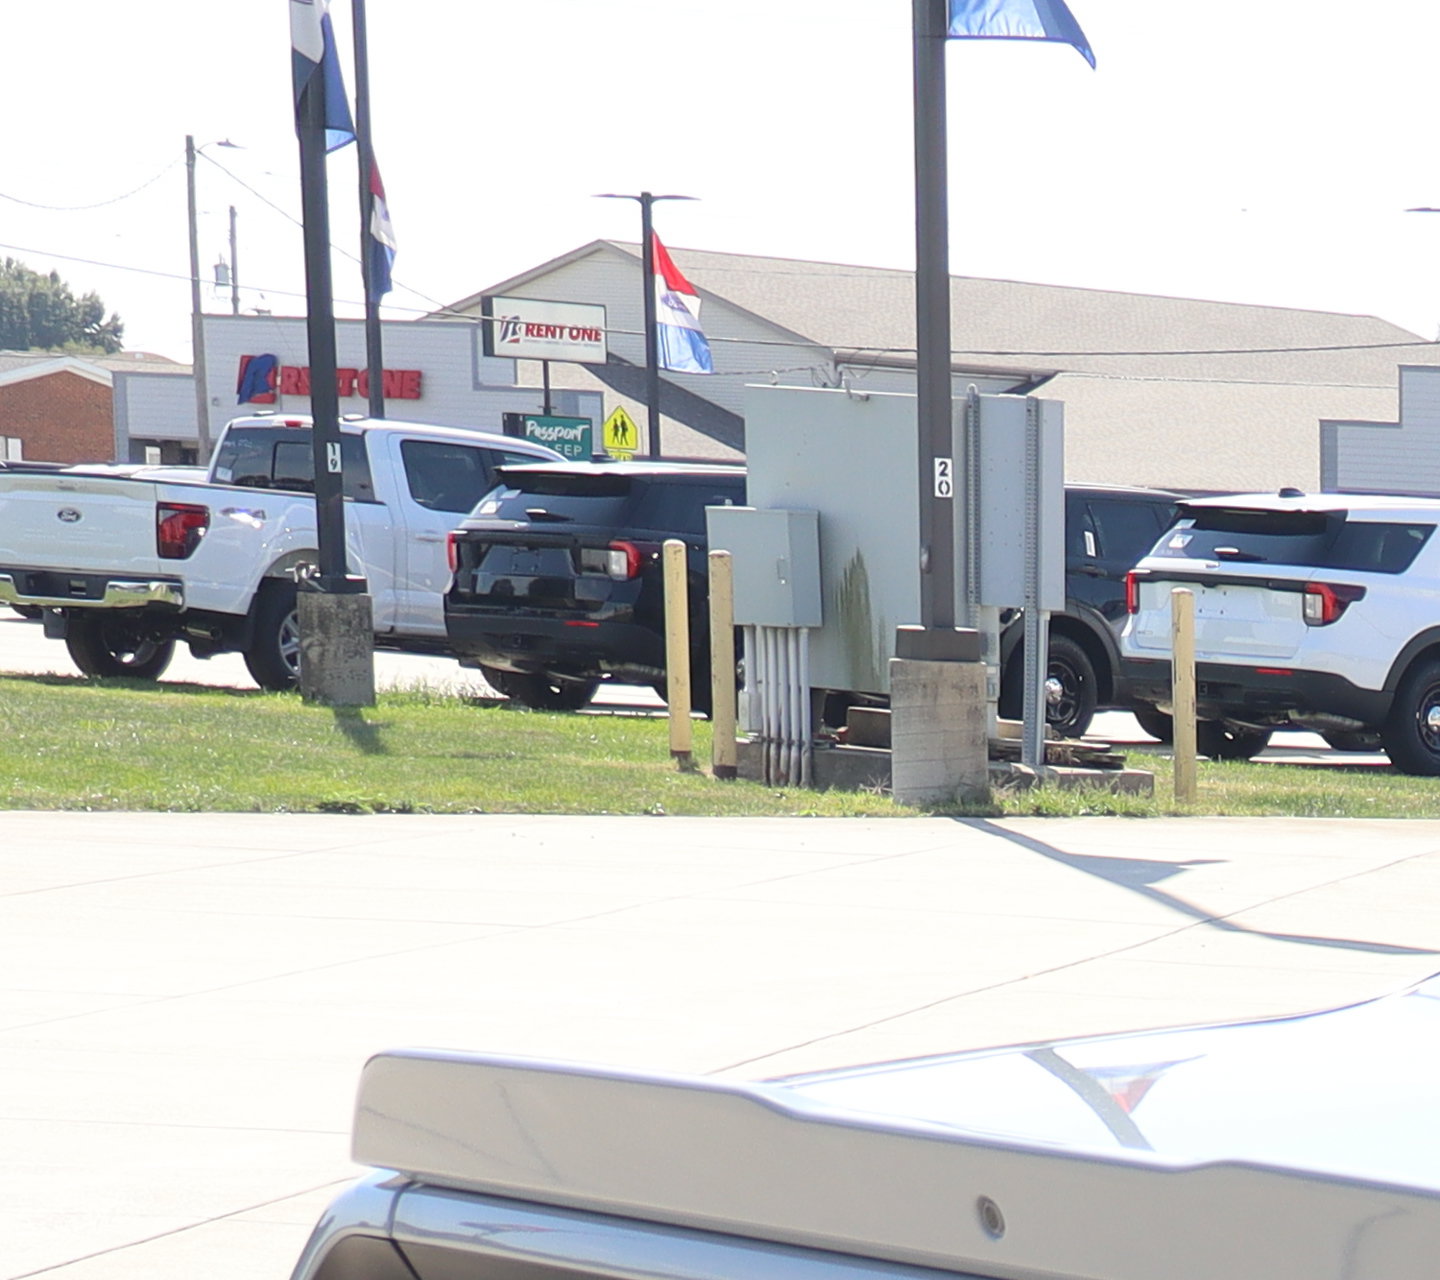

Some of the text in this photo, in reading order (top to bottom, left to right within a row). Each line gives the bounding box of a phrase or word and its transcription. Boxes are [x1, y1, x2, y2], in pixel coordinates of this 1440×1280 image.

[525, 322, 602, 343] RENT ONE
[281, 365, 359, 397] RET
[938, 461, 950, 495] 20
